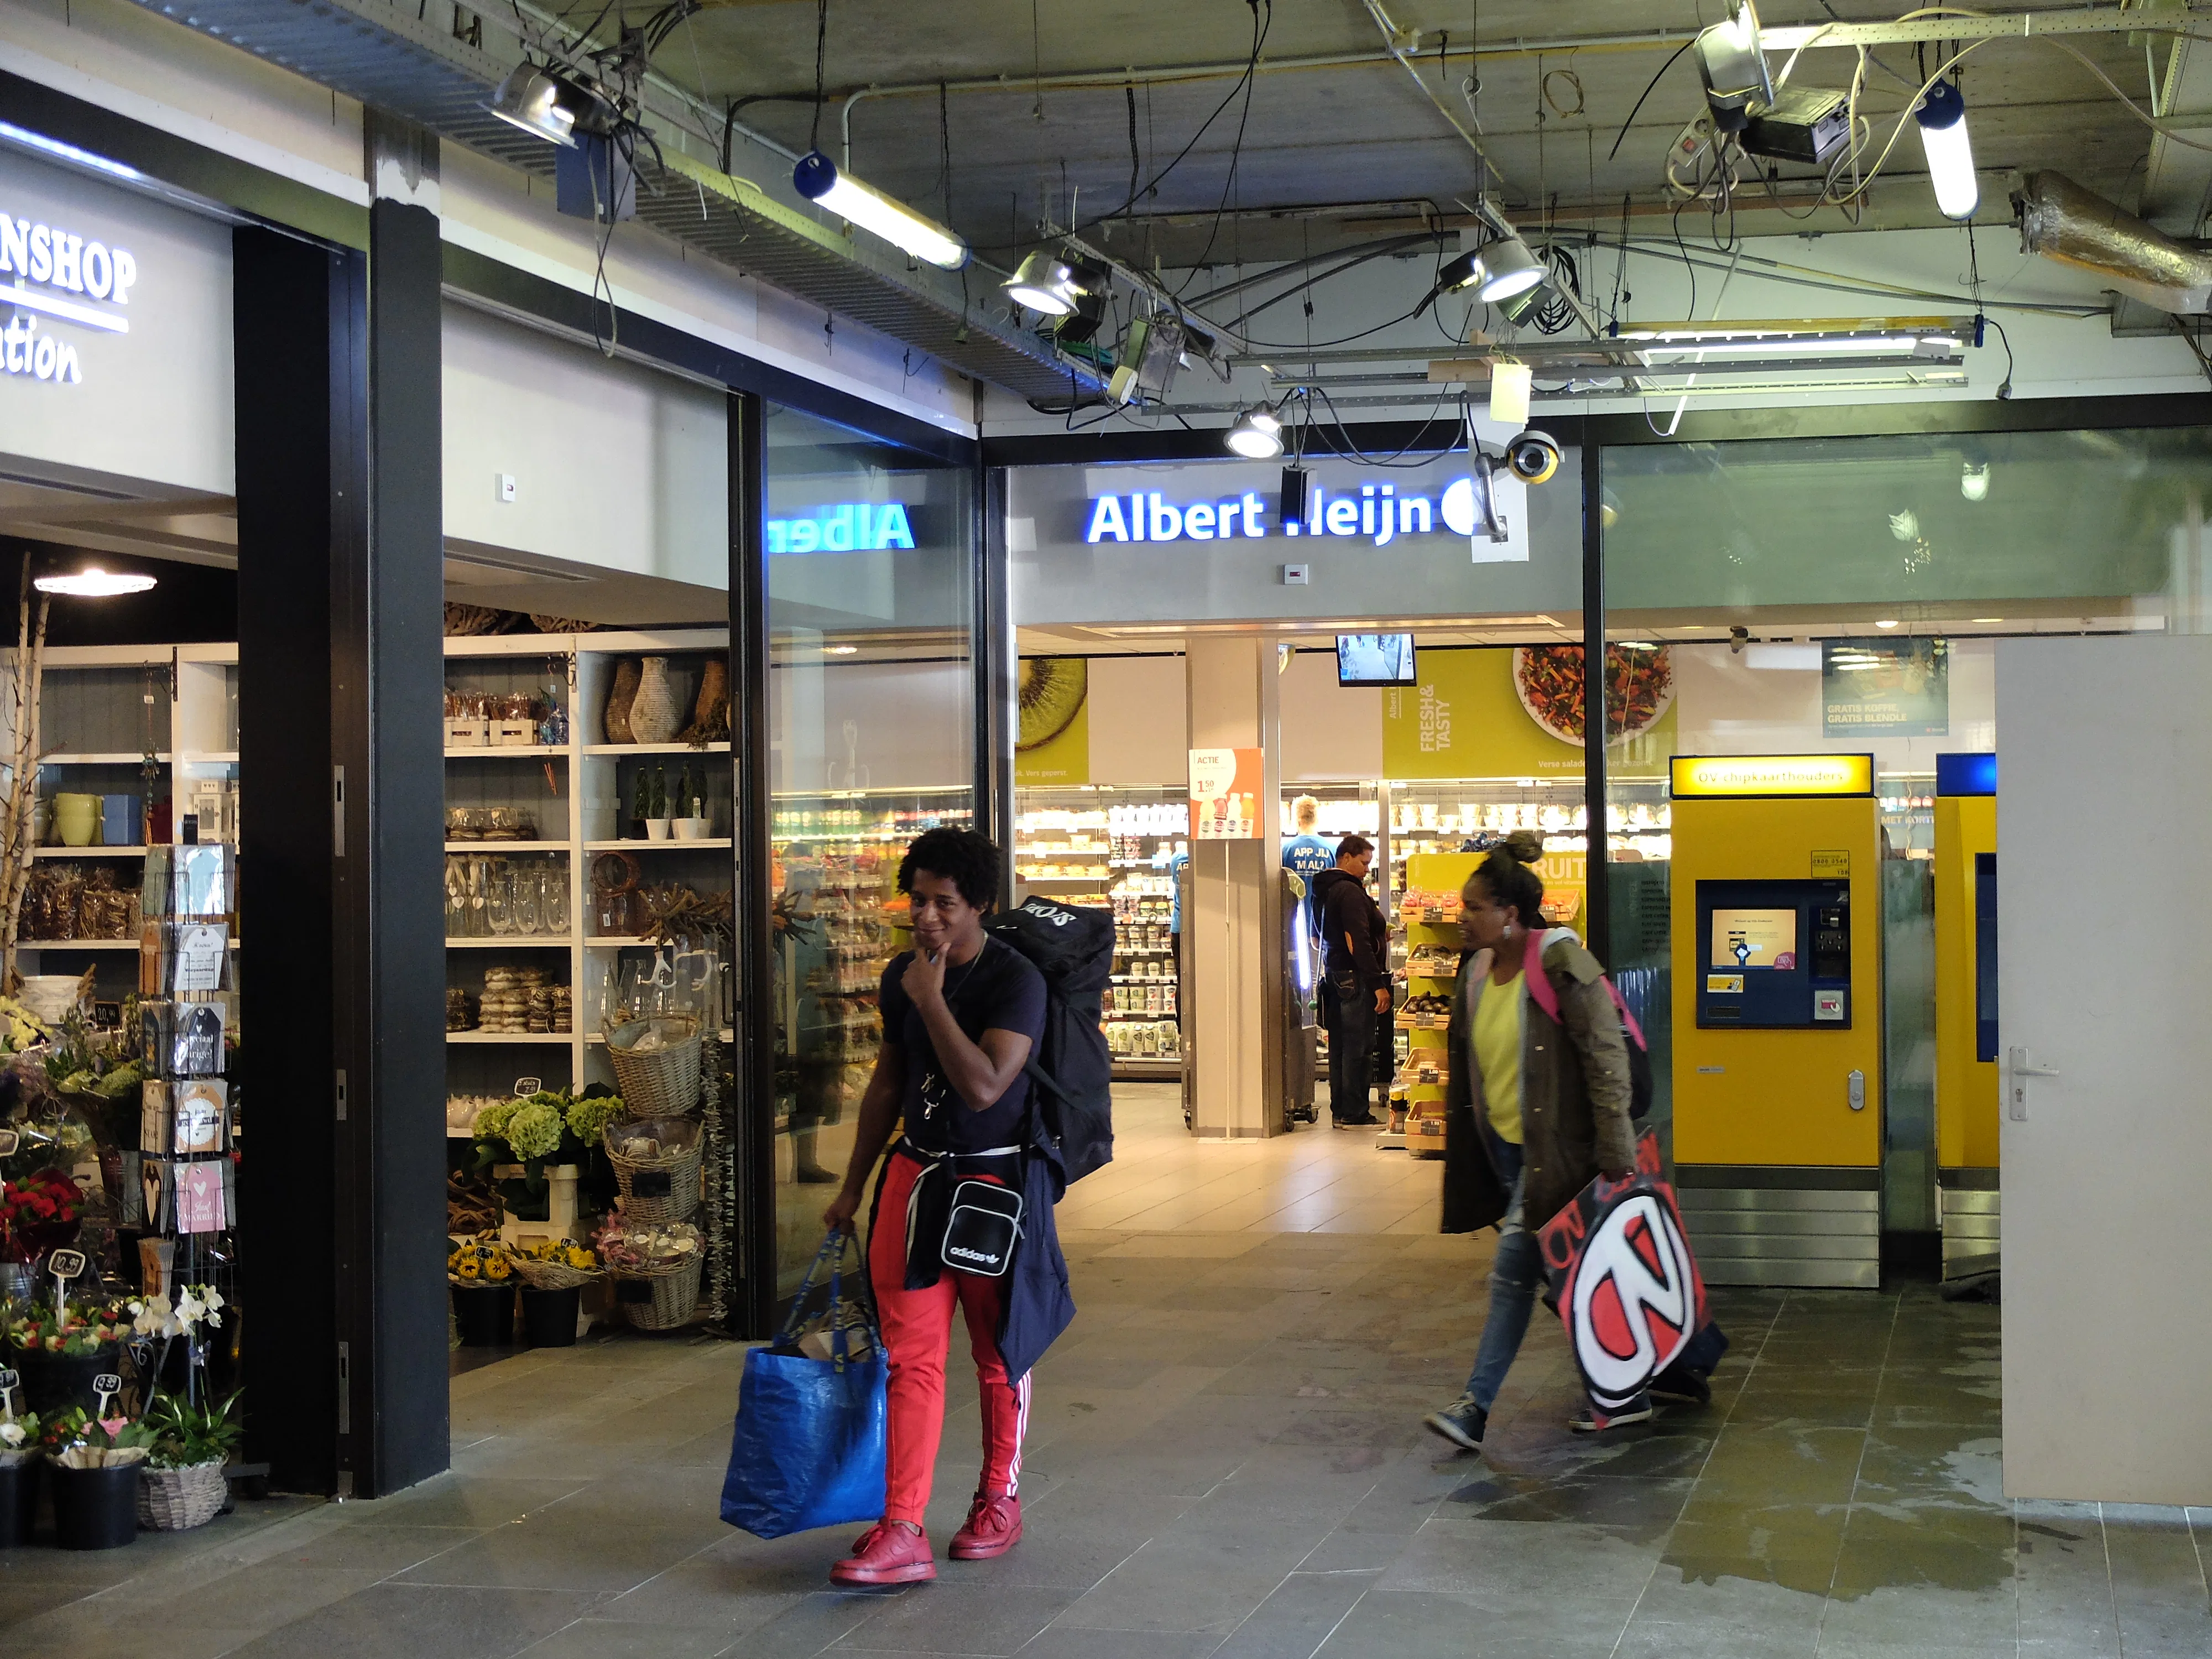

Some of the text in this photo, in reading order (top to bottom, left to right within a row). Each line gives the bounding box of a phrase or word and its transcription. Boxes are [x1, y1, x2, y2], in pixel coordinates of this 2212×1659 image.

[1087, 492, 1265, 544] Albert
[1389, 691, 1397, 719] Albert
[1827, 704, 1863, 713] GRATIS
[1435, 698, 1451, 752] TASTY
[1828, 713, 1908, 723] GRATIS BLENDLE
[1197, 756, 1220, 764] ACTIE
[1294, 847, 1330, 859] APP JIJ
[950, 1246, 986, 1262] adidas
